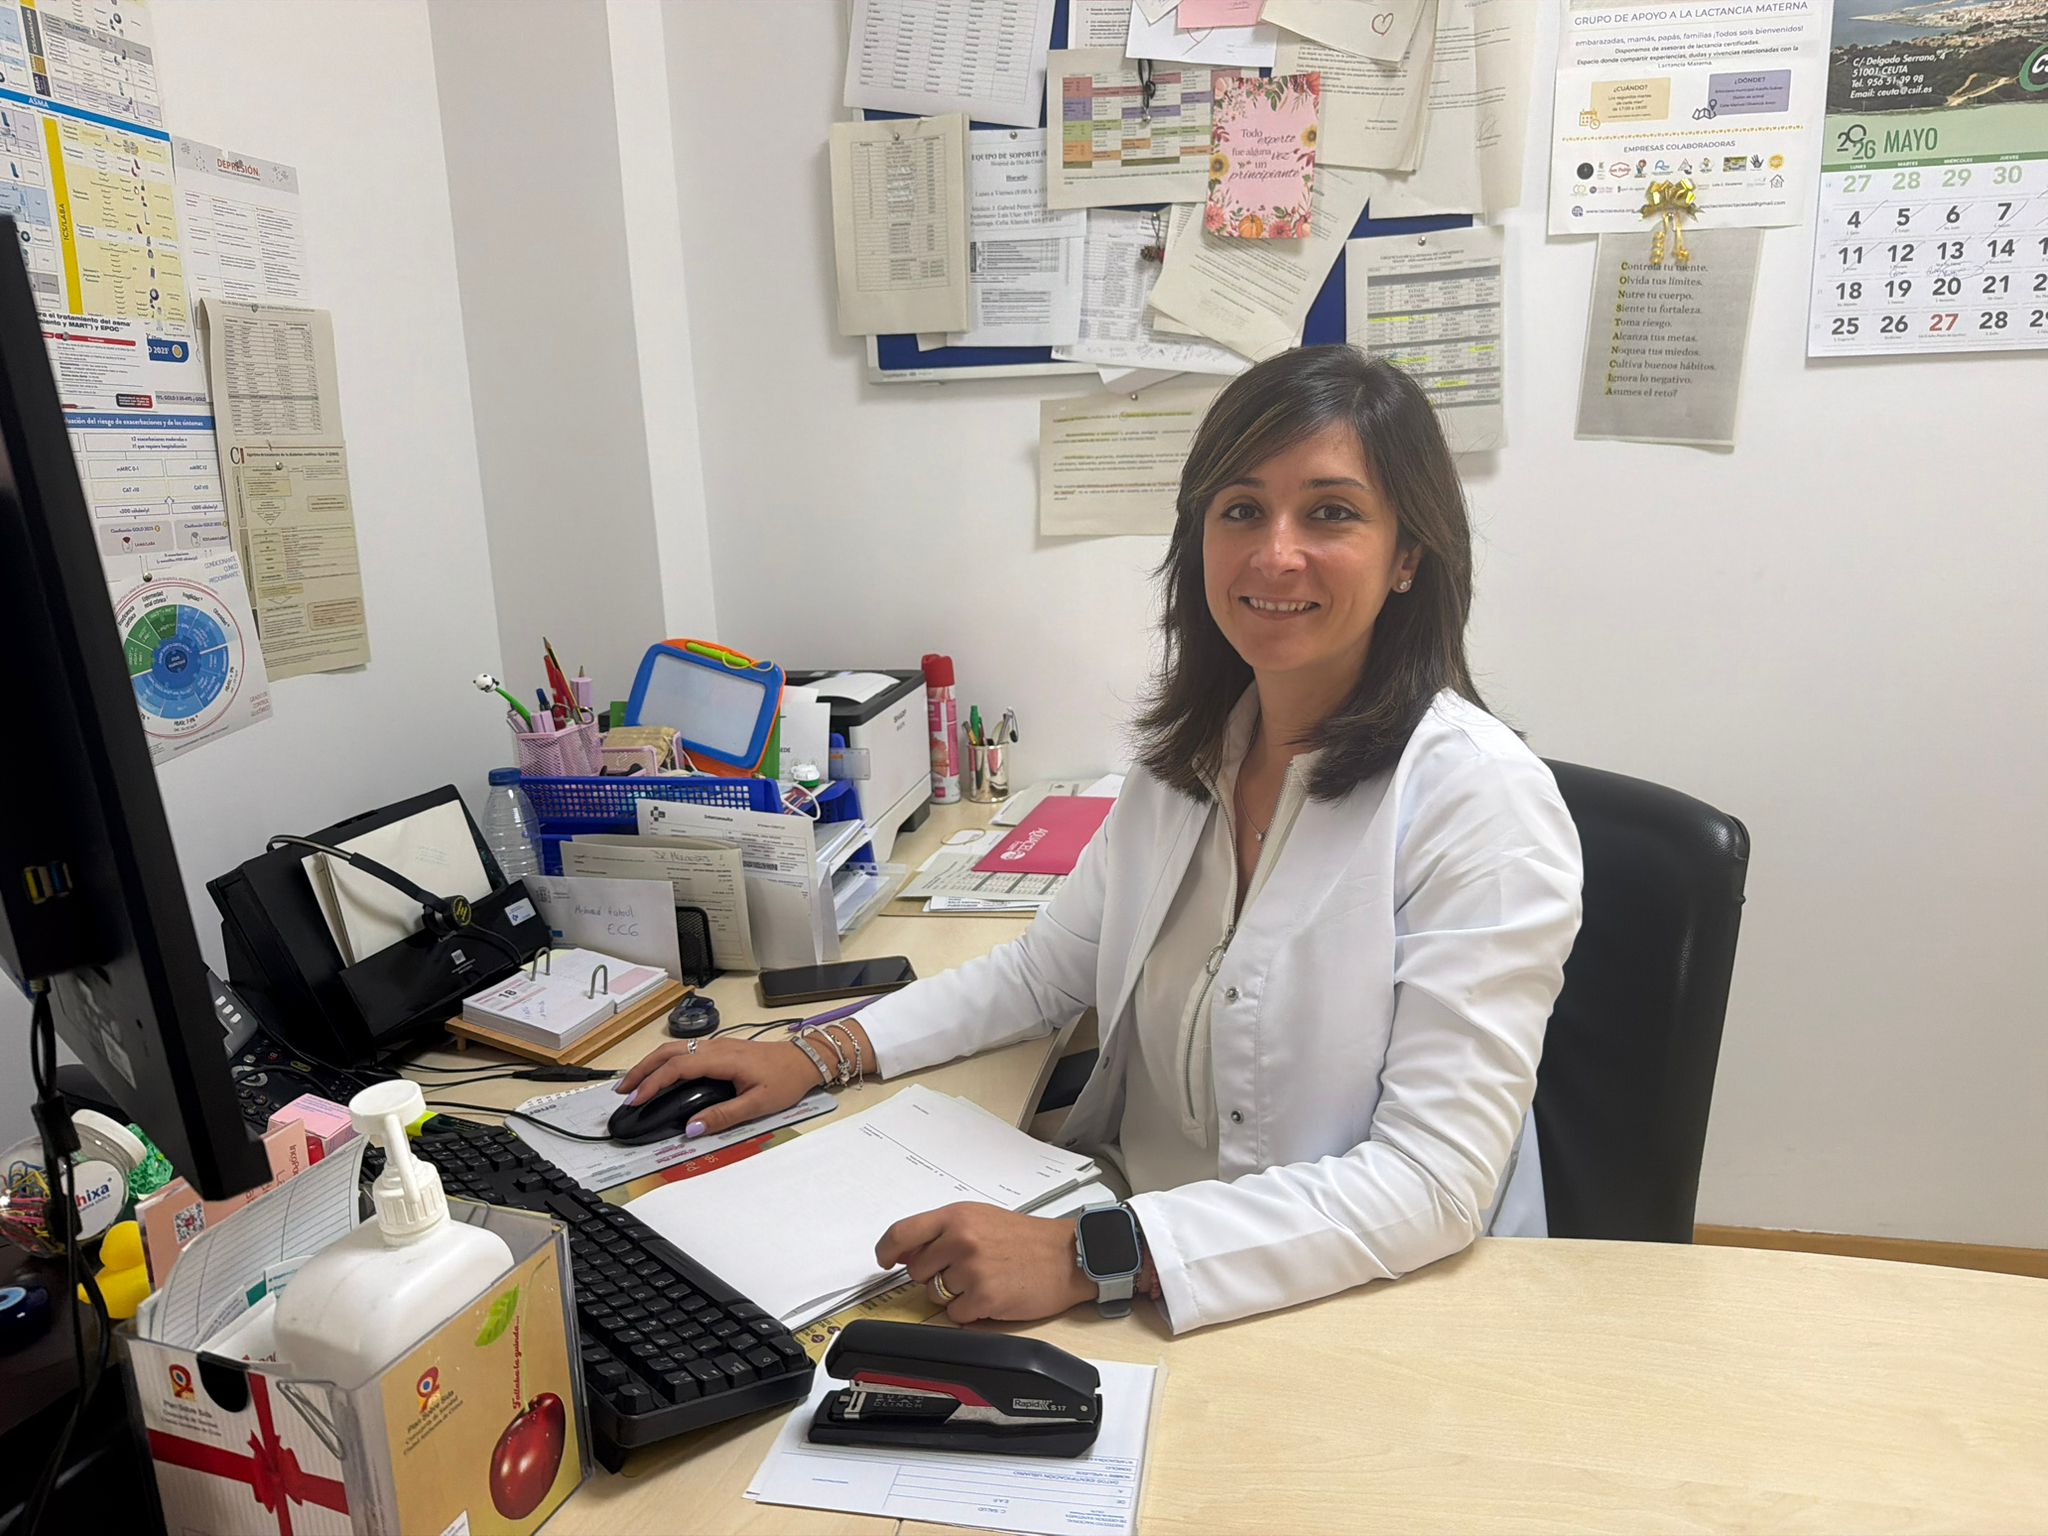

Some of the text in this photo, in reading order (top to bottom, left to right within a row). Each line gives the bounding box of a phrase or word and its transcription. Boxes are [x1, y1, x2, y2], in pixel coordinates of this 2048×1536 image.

[1574, 1, 1808, 26] GRUPO DE APOYO A LA LACTANCIA MATERNA
[1683, 32, 1712, 40] familias
[1739, 28, 1753, 37] sois
[1755, 25, 1804, 35] bienvenidos!
[1696, 41, 1722, 49] lactancia
[1620, 55, 1648, 63] compartir
[1713, 49, 1740, 57] vivencias
[1741, 47, 1779, 55] relacionadas
[1866, 55, 1900, 66] Delgado
[1902, 53, 1938, 63] Serrano,
[1939, 51, 1946, 60] 4
[1852, 65, 1908, 77] 51001 CEUTA
[1734, 76, 1766, 85] ¿DÓNDE?
[1851, 74, 1924, 88] Tel. 956 51 39 98
[1613, 84, 1648, 93] ¿CUÁNDO?
[1850, 89, 1875, 99] Email:
[28, 97, 49, 109] ASMA
[1241, 128, 1263, 139] Todo
[1623, 140, 1736, 153] EMPRESAS COLABORADORAS
[1883, 127, 1939, 154] MAYO
[971, 150, 1040, 162] EQUIPO DE SOPORTE
[1231, 147, 1290, 161] fue alguna vez
[216, 158, 260, 177] DEPRESIÓN
[1255, 161, 1268, 169] un
[1228, 169, 1300, 184] principiante
[1842, 165, 2023, 193] 27 28 29 30
[1847, 202, 2012, 229] 4 5 6 7
[58, 203, 71, 241] ICS/LABA
[1837, 238, 2016, 265] 11 12 13 14
[1619, 276, 1650, 285] Olvida
[1835, 275, 2010, 300] 18 19 20 21
[1618, 290, 1645, 299] Nutre
[1658, 293, 1694, 302] cuerpo.
[1615, 304, 1645, 313] Siente
[56, 313, 99, 323] tratamiento
[99, 317, 112, 325] del
[1614, 318, 1672, 329] Toma riesgo.
[1831, 311, 2009, 335] 25 26 27 28
[1612, 332, 1648, 341] Alcanza
[1611, 346, 1646, 356] Noquea
[1609, 359, 1642, 369] Cultiva
[1644, 360, 1678, 369] buenos
[1608, 373, 1638, 383] Ignora
[1639, 374, 1648, 382] lo
[1605, 387, 1678, 398] Asumes el reto?
[87, 417, 96, 425] del
[97, 418, 114, 427] riesgo
[115, 418, 123, 426] de
[123, 419, 163, 427] exacerbaciones
[182, 419, 203, 427] síntomas
[204, 555, 237, 569] CONDICIONANTE
[498, 989, 518, 998] 18
[1013, 1399, 1040, 1409] Rapid
[1012, 1470, 1043, 1478] USUARIO
